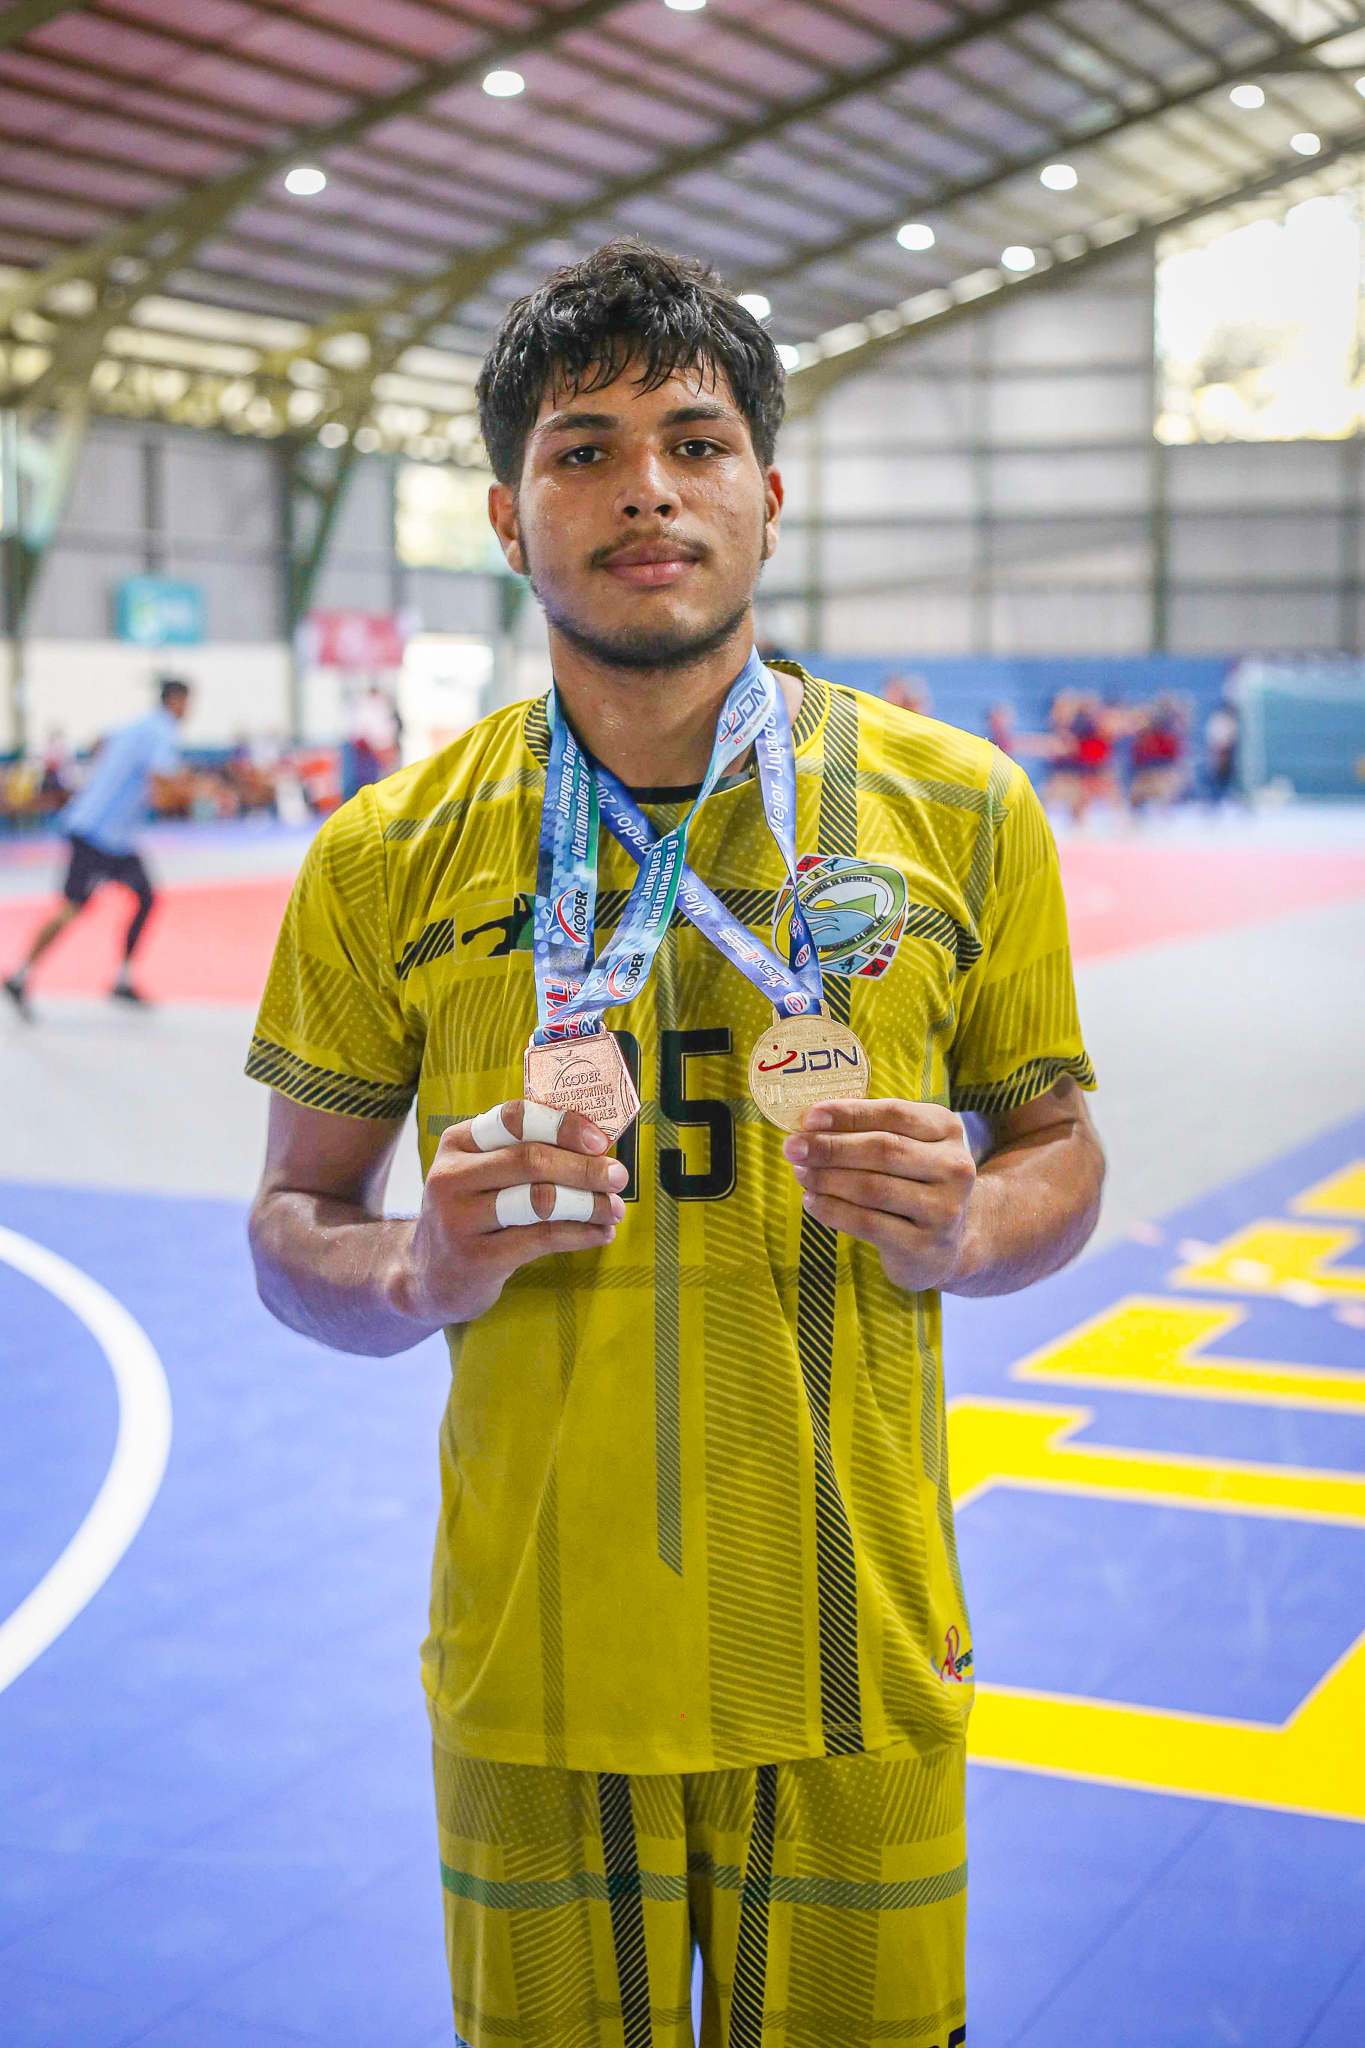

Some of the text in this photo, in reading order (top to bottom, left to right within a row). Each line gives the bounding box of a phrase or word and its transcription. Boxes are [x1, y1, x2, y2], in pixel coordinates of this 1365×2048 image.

[730, 678, 768, 737] JDN
[556, 764, 575, 819] Juegos
[768, 781, 789, 838] Mejor
[571, 781, 591, 859] Nacionales
[640, 850, 662, 900] Juegos
[644, 852, 677, 929] Nacionales
[841, 875, 873, 883] DEPORTES
[573, 890, 589, 935] ICODER
[678, 879, 712, 917] Mejo
[620, 952, 646, 993] ICODER
[561, 1071, 601, 1088] ICODER
[782, 1045, 859, 1075] JDN
[571, 1083, 614, 1100] DEPORTIVOS
